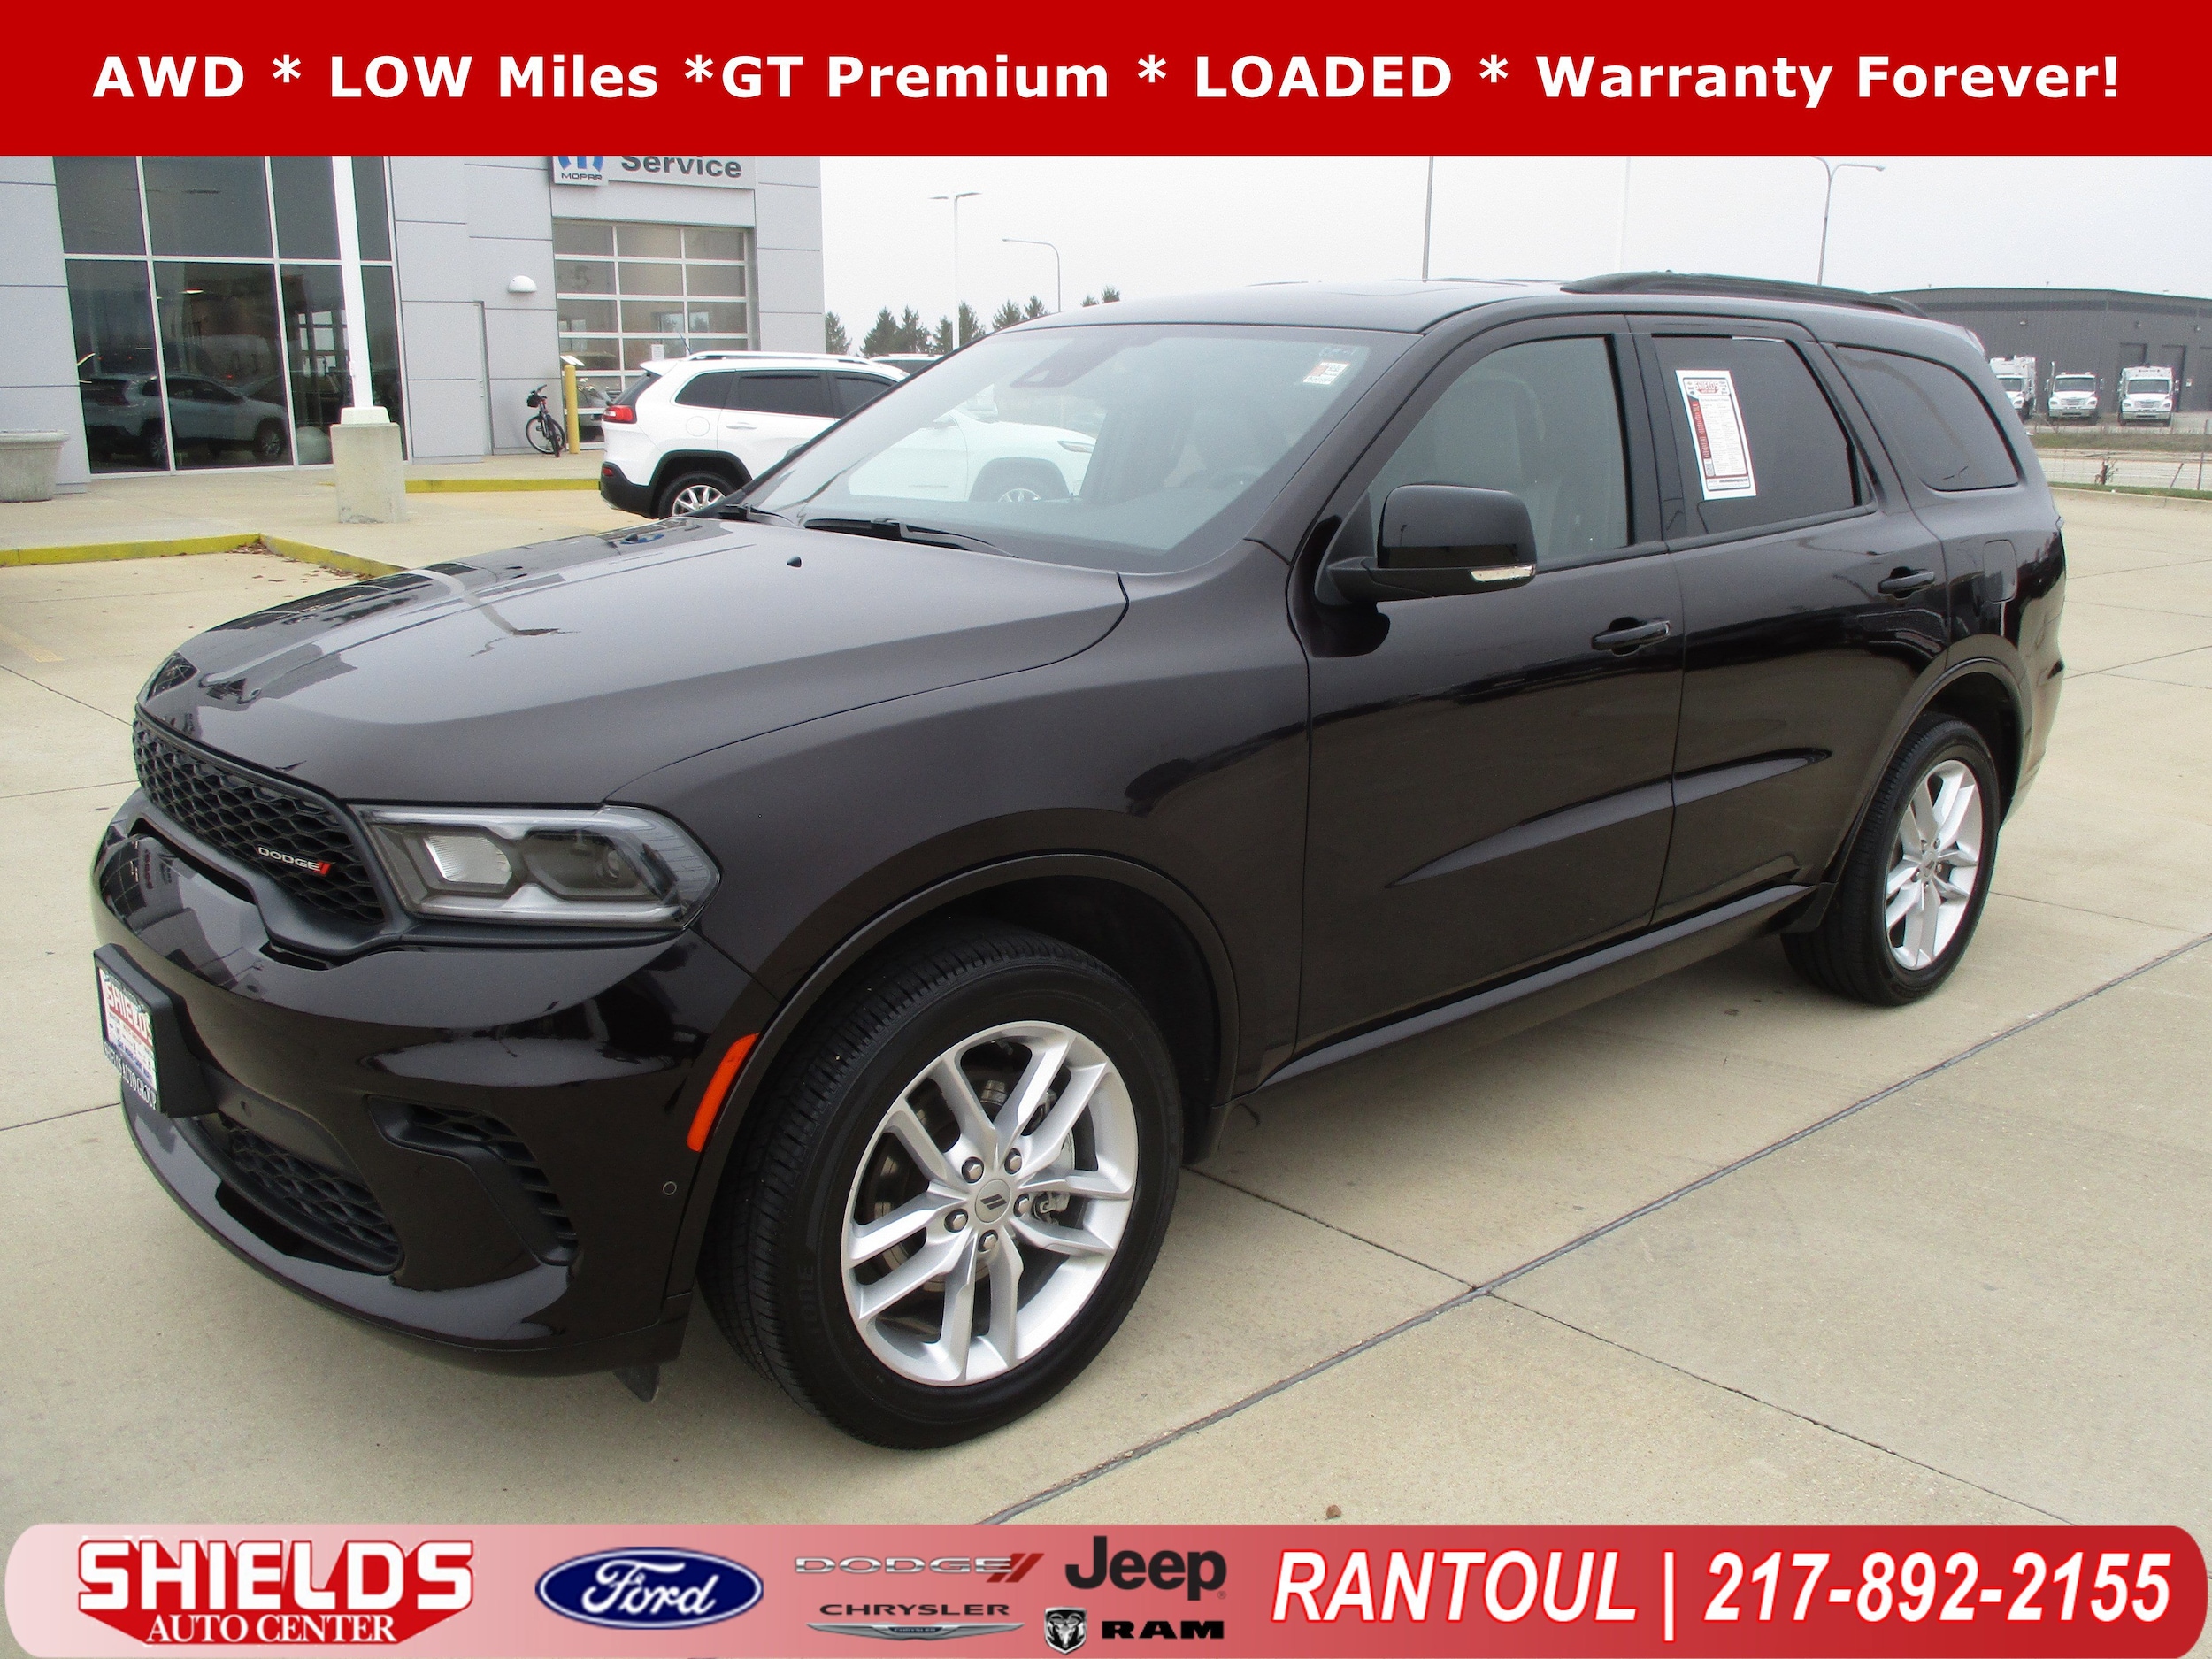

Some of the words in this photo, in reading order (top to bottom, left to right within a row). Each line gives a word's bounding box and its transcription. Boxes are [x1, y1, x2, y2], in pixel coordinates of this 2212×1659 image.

[561, 172, 603, 181] MOPAR
[620, 156, 742, 179] Service
[257, 846, 321, 872] DODGE
[106, 982, 153, 1044] SHIELDS
